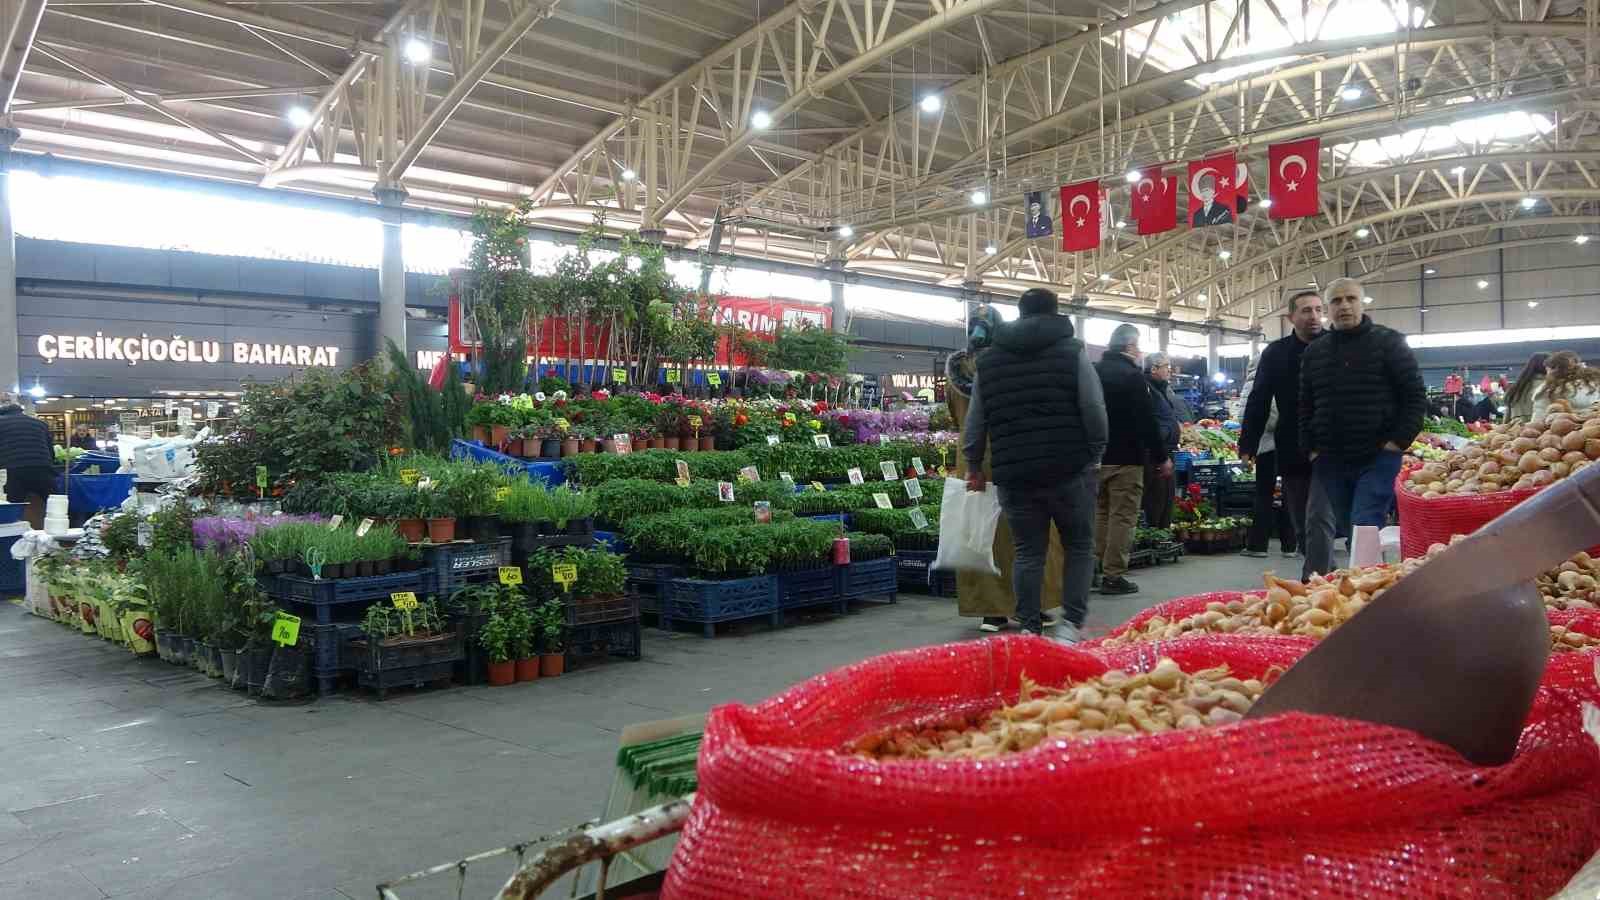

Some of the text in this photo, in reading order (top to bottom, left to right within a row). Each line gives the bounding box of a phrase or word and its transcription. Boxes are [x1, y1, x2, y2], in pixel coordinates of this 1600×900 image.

[37, 331, 339, 367] ÇERİKÇİOĞLU BAHARAT
[891, 374, 919, 388] YAYLA
